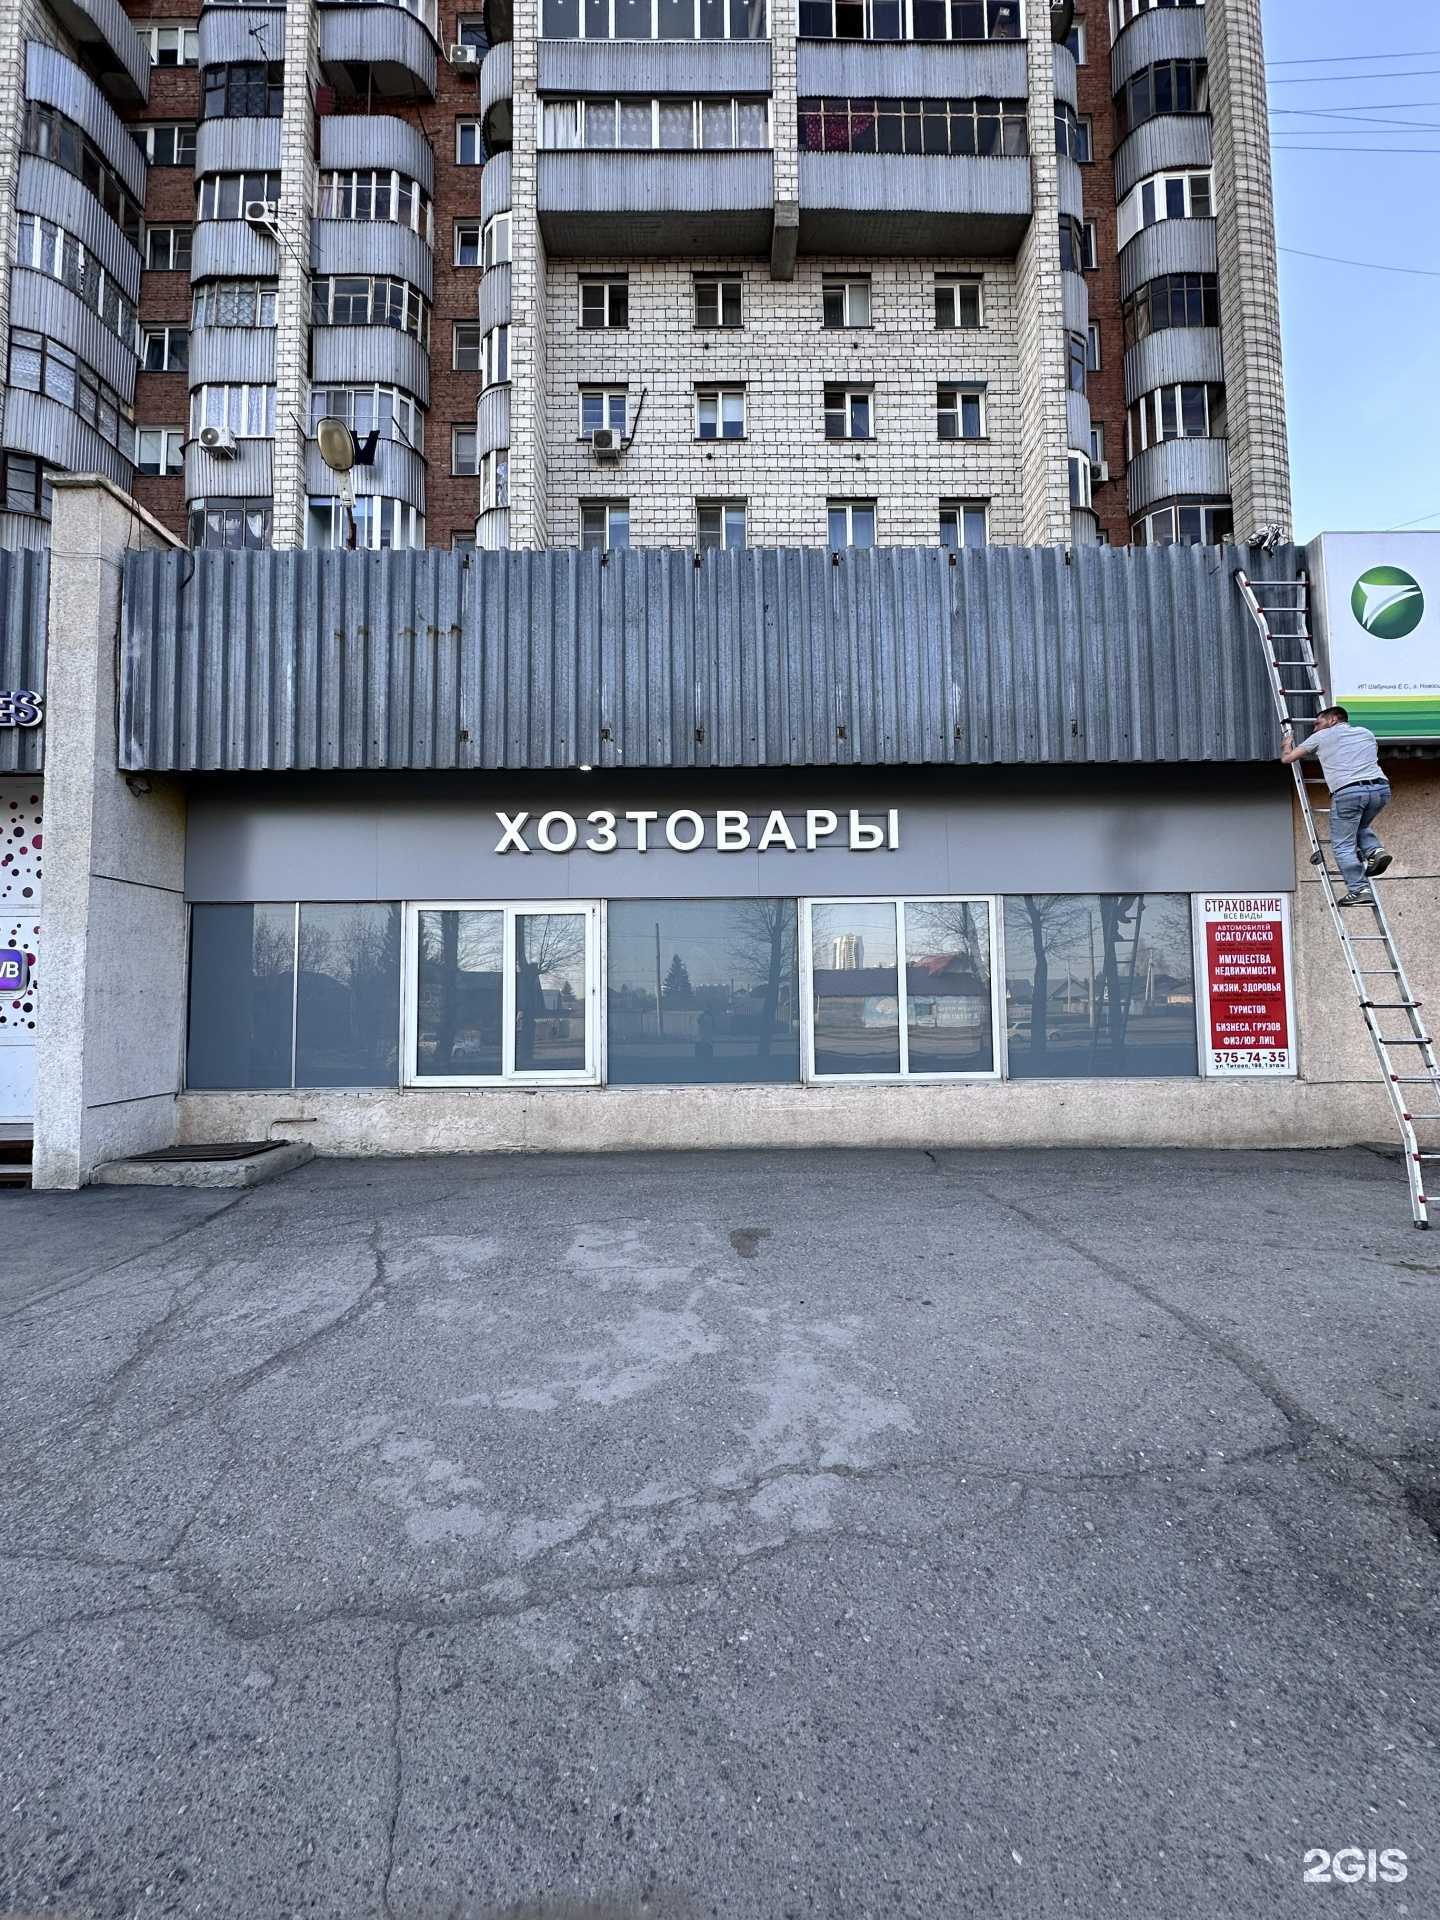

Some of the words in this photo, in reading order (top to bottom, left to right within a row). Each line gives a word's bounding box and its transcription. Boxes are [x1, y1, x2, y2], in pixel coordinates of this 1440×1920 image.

[494, 809, 900, 854] ХОЗТОВАРЫ
[1205, 900, 1281, 912] СТРАХОВАНИЕ
[1215, 932, 1273, 942] ОСАГО/КАСКО
[1219, 954, 1271, 965] ИМУЩЕСТВА
[1215, 966, 1277, 976] НЕДВИЖИМОСТИ
[1243, 983, 1281, 993] ЗДОРОВЬЯ
[1229, 1005, 1267, 1014] ТУРИСТОВ
[1214, 1052, 1286, 1062] 375-74-35
